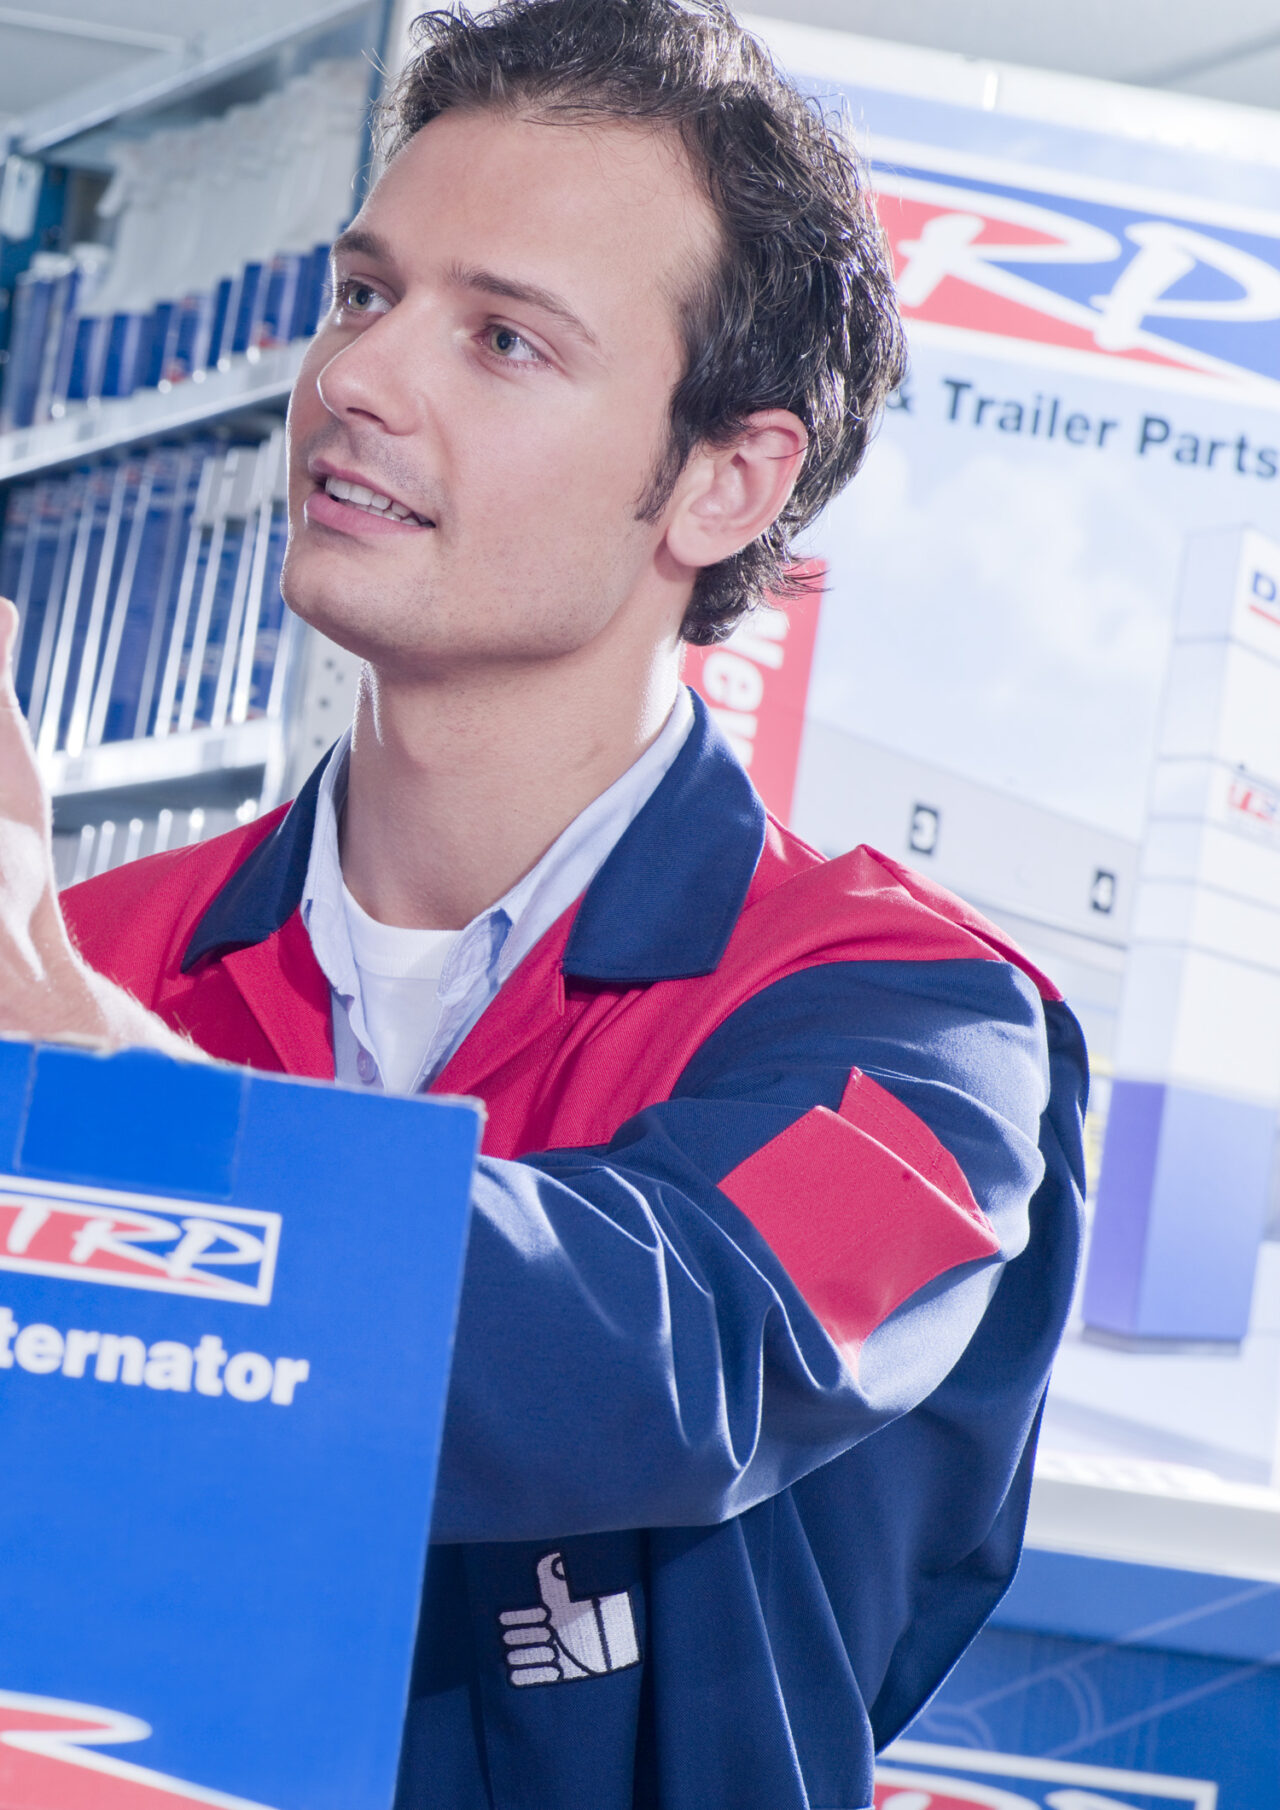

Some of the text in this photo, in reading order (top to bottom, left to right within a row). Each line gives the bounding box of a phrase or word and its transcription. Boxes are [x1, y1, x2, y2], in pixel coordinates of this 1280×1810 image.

[885, 180, 1280, 385] RP
[942, 376, 1119, 449] Trailer
[1136, 414, 1280, 481] Parts
